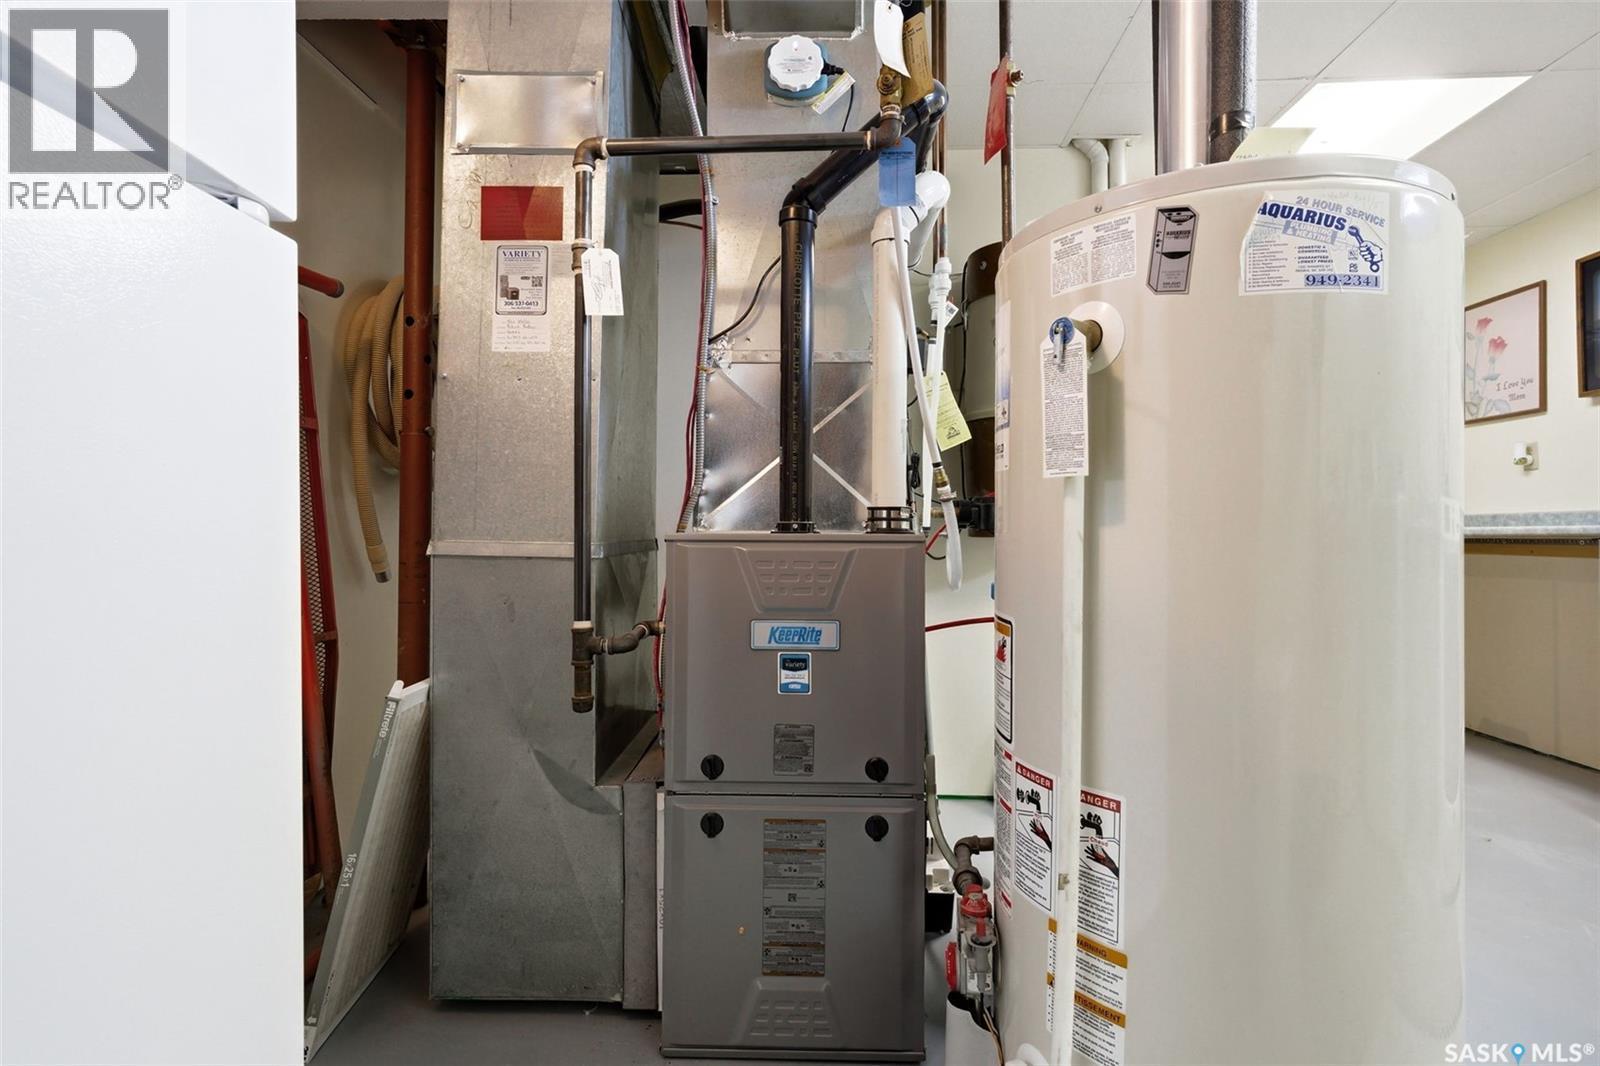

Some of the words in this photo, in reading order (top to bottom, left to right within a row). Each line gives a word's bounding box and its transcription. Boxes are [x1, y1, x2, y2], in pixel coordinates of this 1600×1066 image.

[1257, 202, 1347, 231] AQUARIUS
[1296, 196, 1309, 206] 24
[1312, 198, 1343, 213] HOUR
[1345, 206, 1386, 228] SERVICE
[502, 250, 543, 258] VARIETY
[792, 311, 802, 342] PIPE
[1022, 768, 1051, 788] DANGER
[1080, 792, 1118, 811] ANGER
